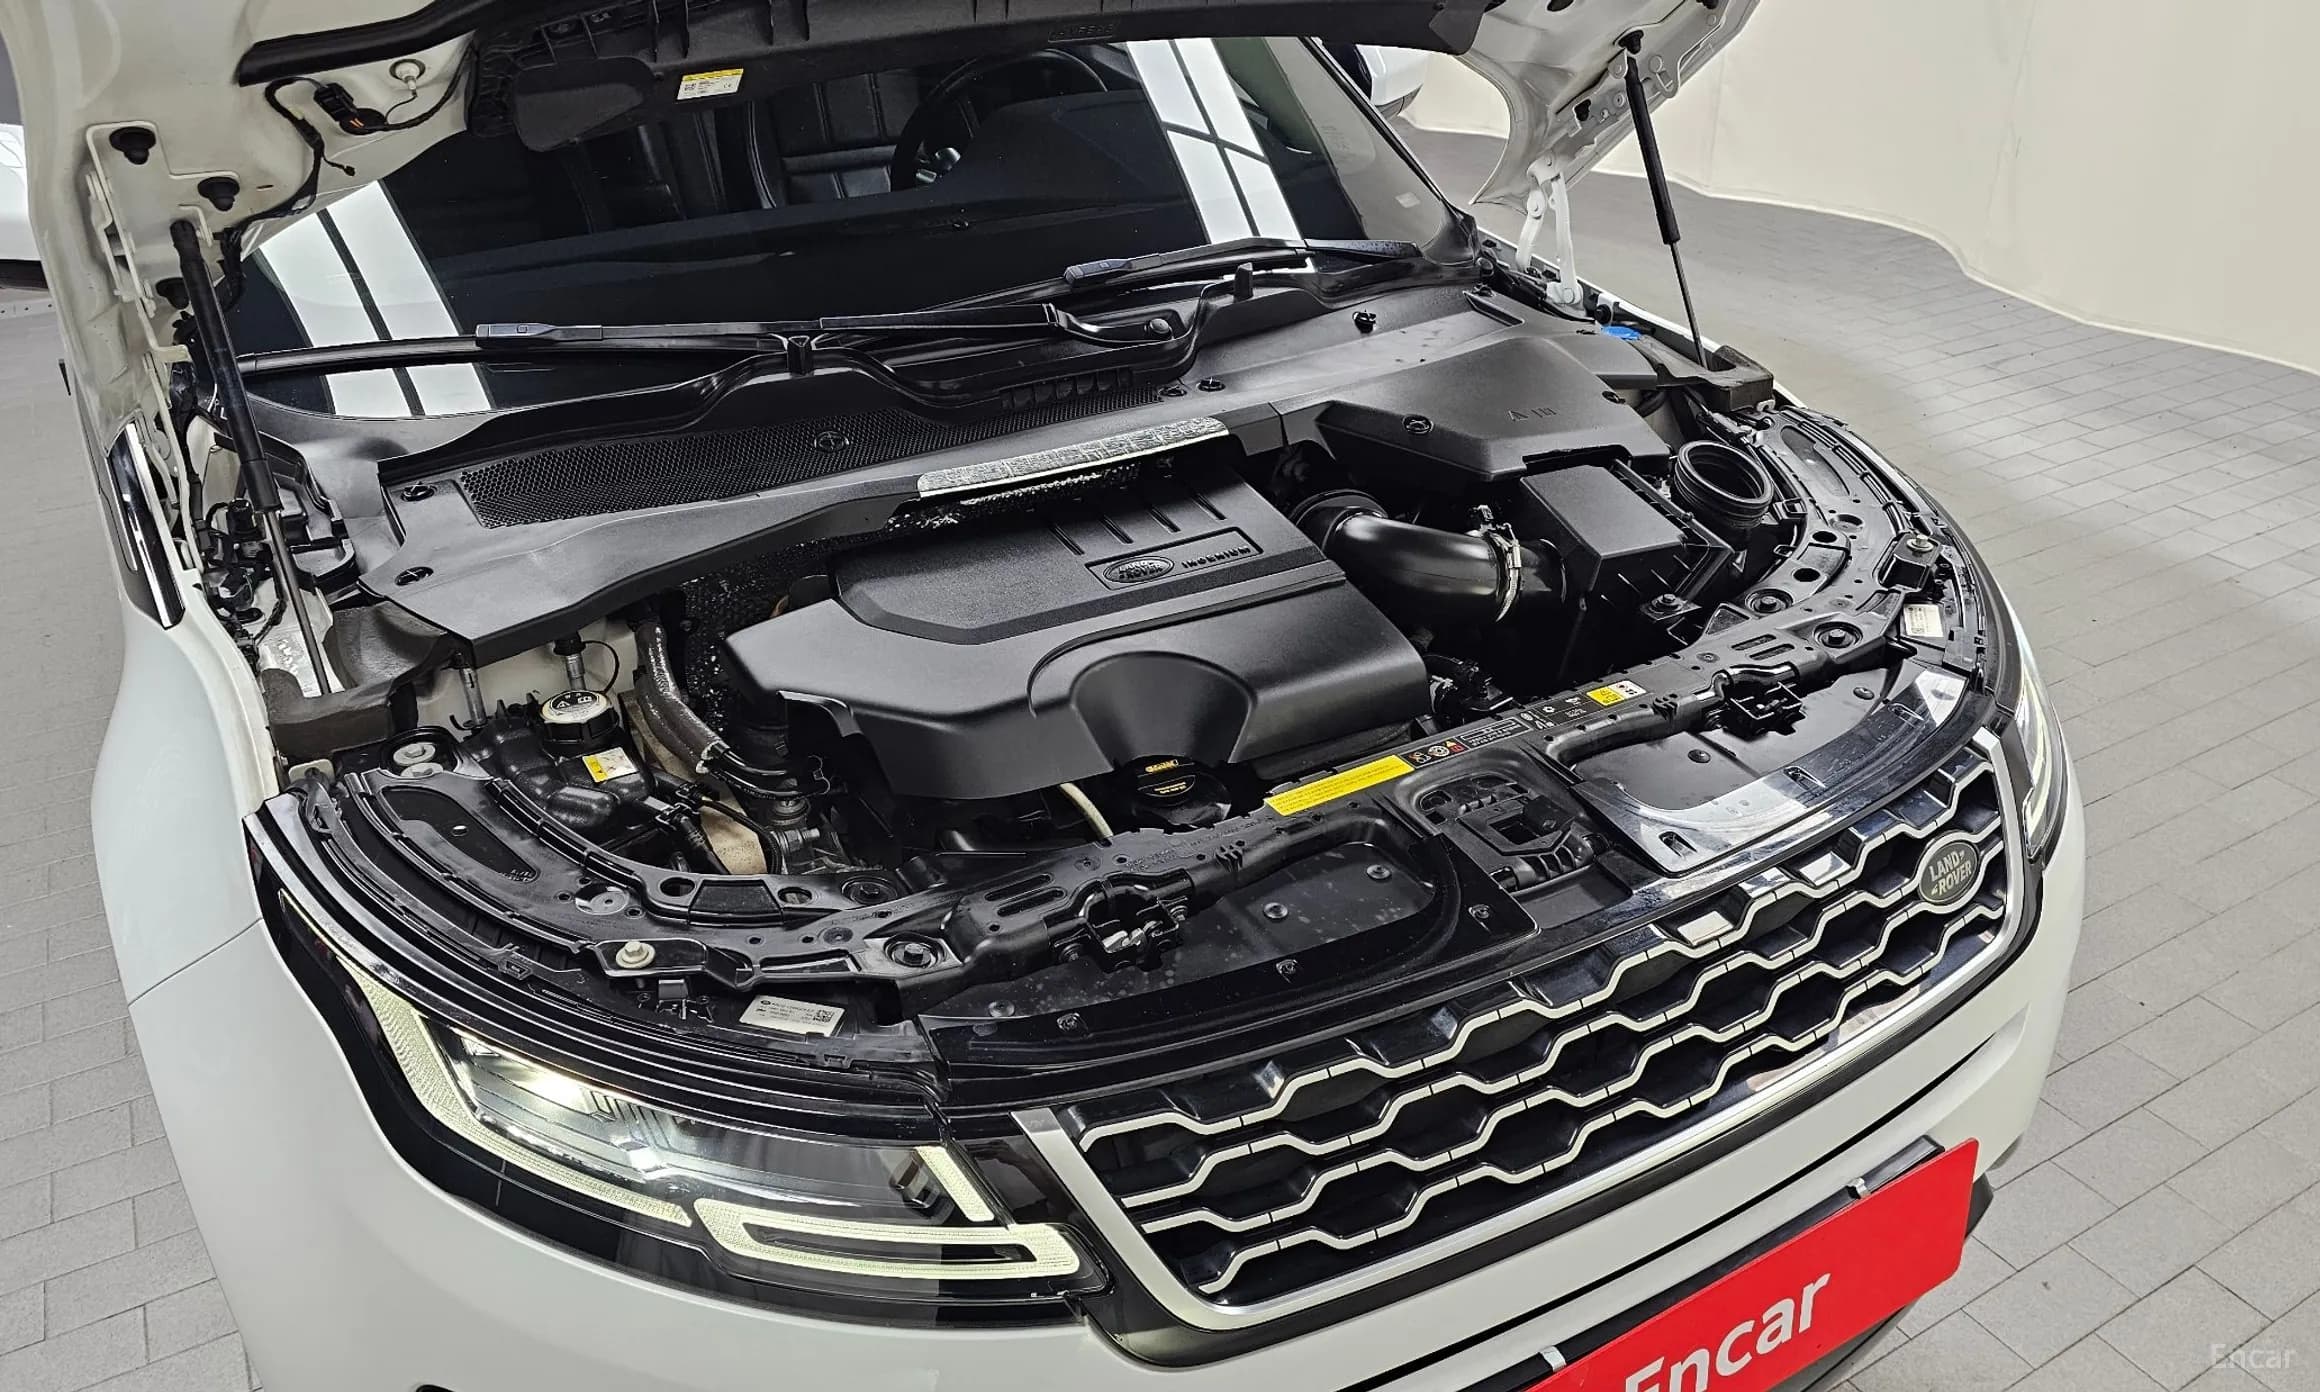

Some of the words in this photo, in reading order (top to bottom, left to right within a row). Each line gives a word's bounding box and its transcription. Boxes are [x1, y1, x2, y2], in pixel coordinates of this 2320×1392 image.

[1119, 560, 1149, 574] LAND
[1181, 546, 1251, 569] INGENIUM
[1126, 565, 1164, 580] ROVER
[1929, 851, 1960, 882] LAND
[1938, 860, 1972, 896] ROVER
